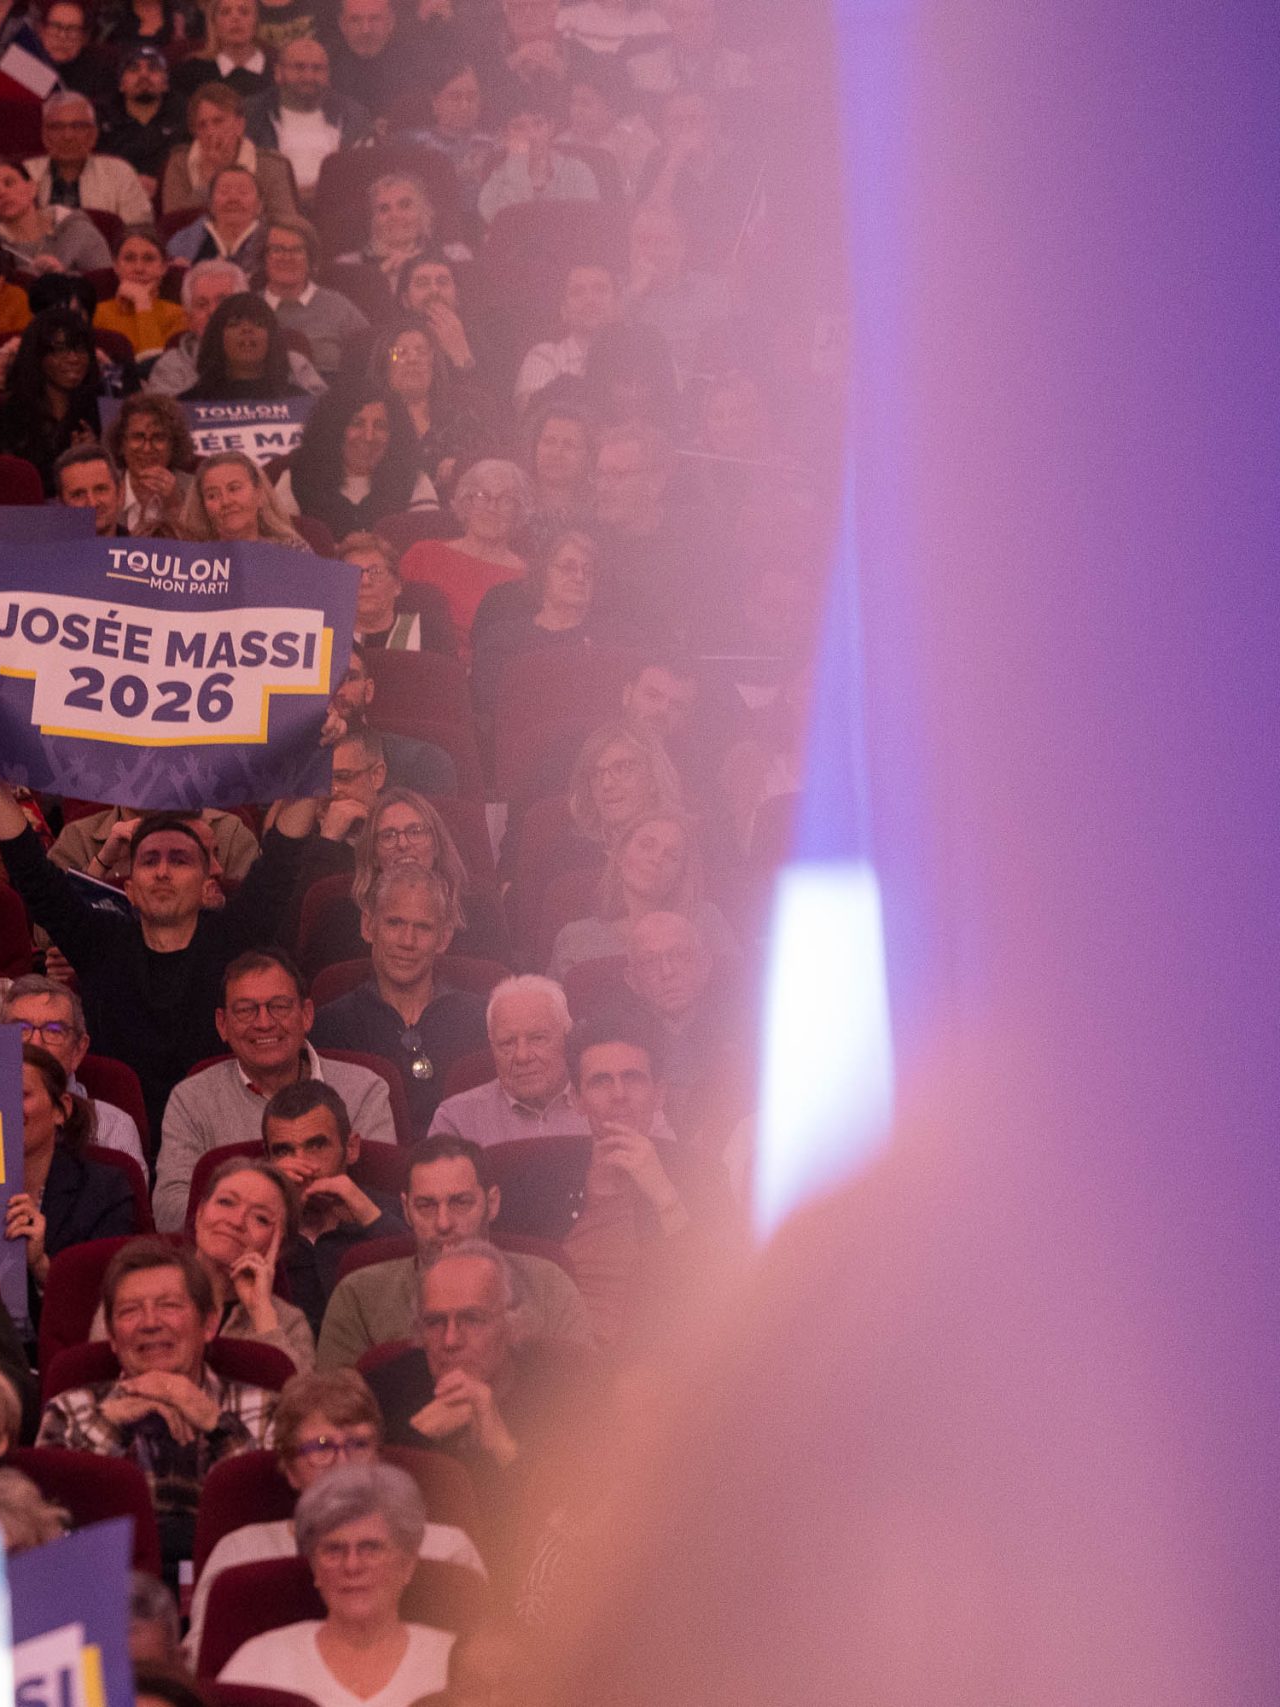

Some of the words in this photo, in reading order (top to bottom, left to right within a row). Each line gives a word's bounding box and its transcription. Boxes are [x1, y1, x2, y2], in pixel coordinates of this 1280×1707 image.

[196, 405, 288, 418] TOULON
[108, 548, 231, 582] TOULON
[149, 576, 186, 594] MON
[189, 580, 229, 594] PARTI
[164, 630, 318, 670] MASSI
[63, 666, 236, 724] 2026
